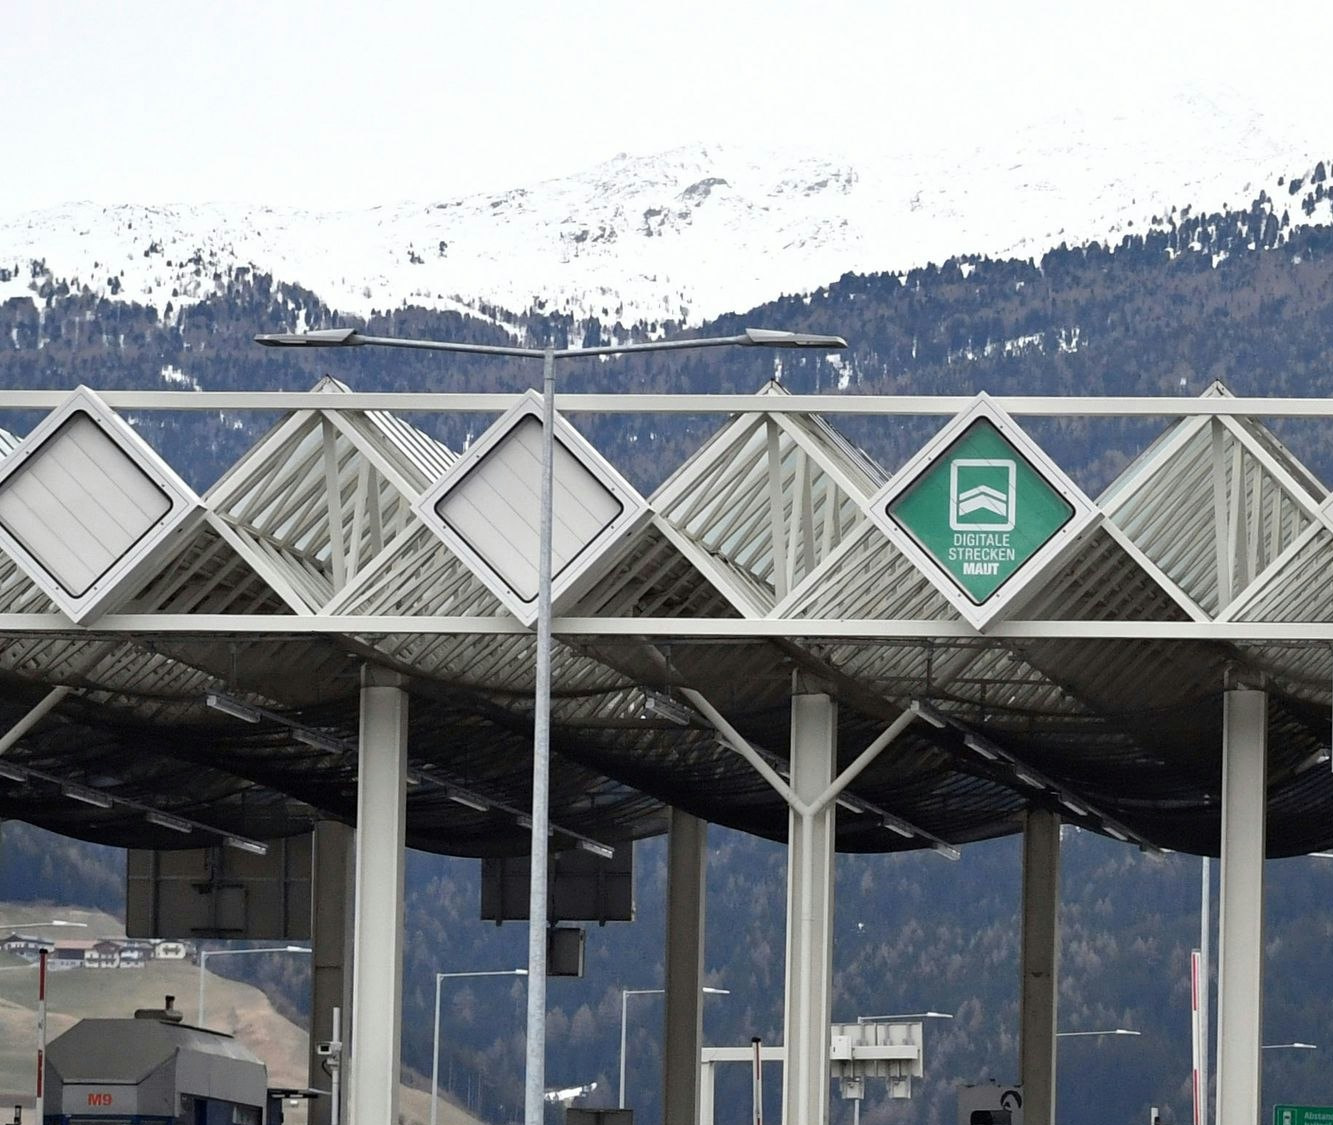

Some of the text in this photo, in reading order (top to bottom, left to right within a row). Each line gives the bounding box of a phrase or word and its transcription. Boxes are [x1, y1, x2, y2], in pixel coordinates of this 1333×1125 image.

[953, 533, 1010, 547] DIGITALE
[948, 547, 1015, 561] STRECKEN
[963, 562, 1000, 575] MAUT
[88, 1093, 112, 1106] M9
